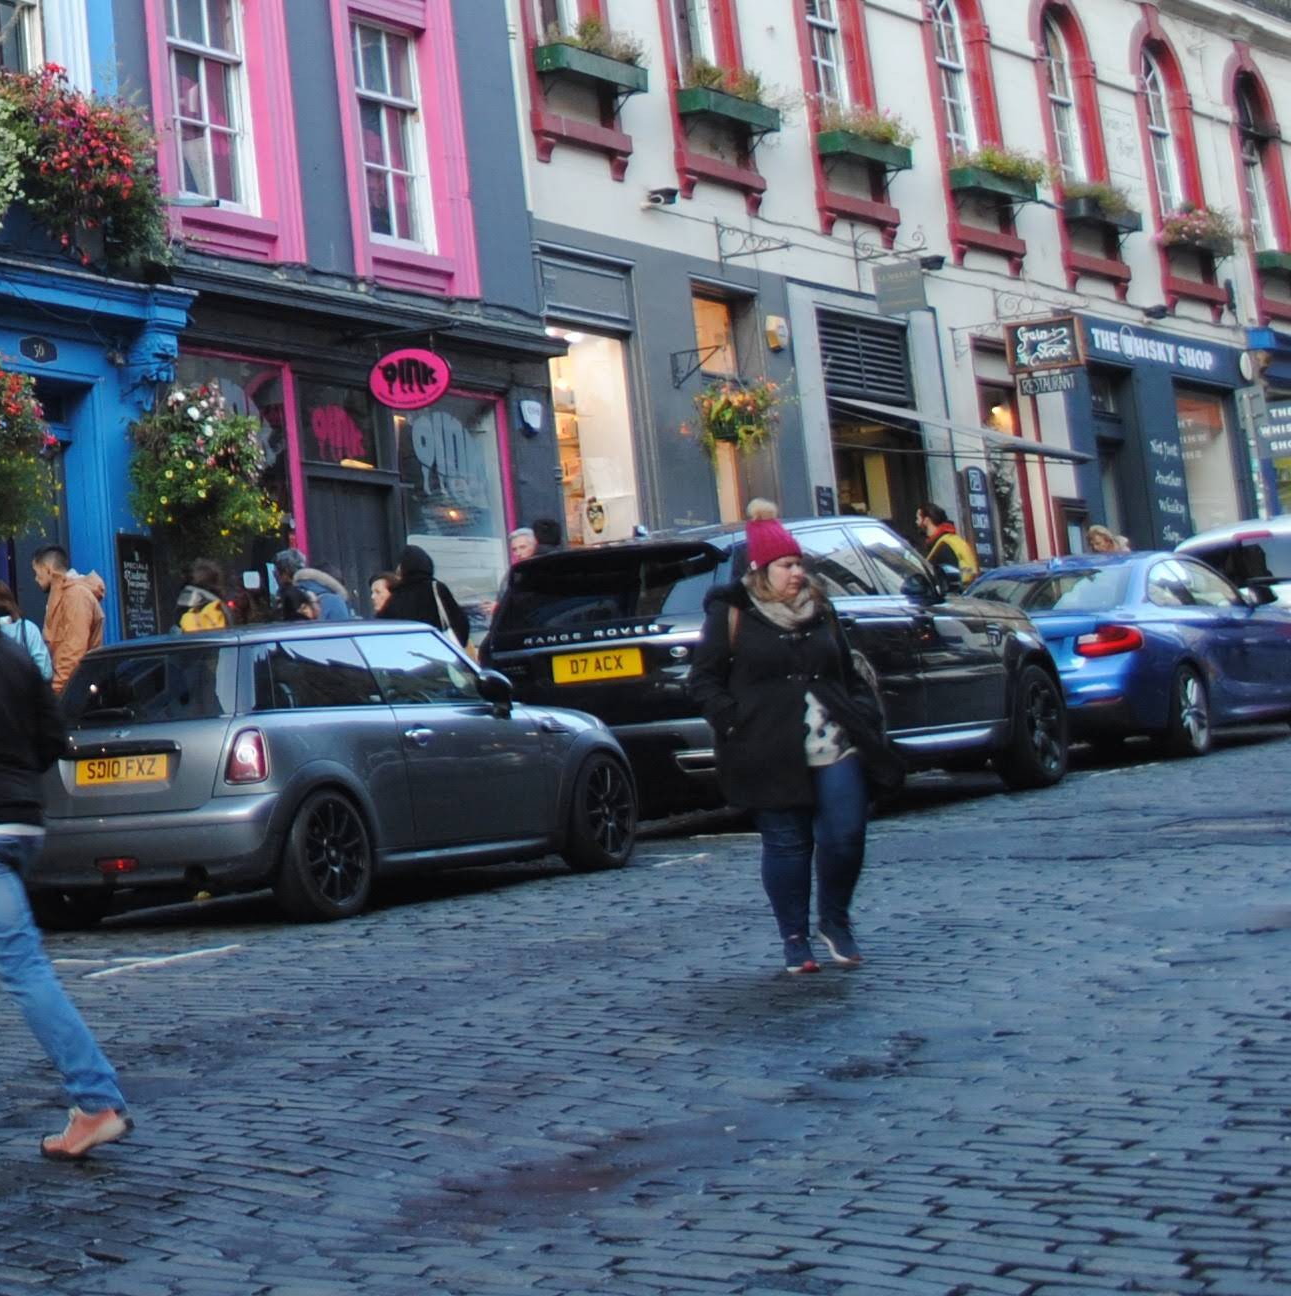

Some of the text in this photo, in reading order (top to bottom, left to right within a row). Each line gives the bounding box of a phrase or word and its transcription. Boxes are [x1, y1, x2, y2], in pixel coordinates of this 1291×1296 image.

[1090, 327, 1214, 371] THE WHISKY SHOP
[1021, 373, 1076, 395] RESTAURANT
[523, 624, 661, 645] RANGE ROVER
[570, 655, 624, 675] D7 ACX
[125, 757, 157, 779] FXZ
